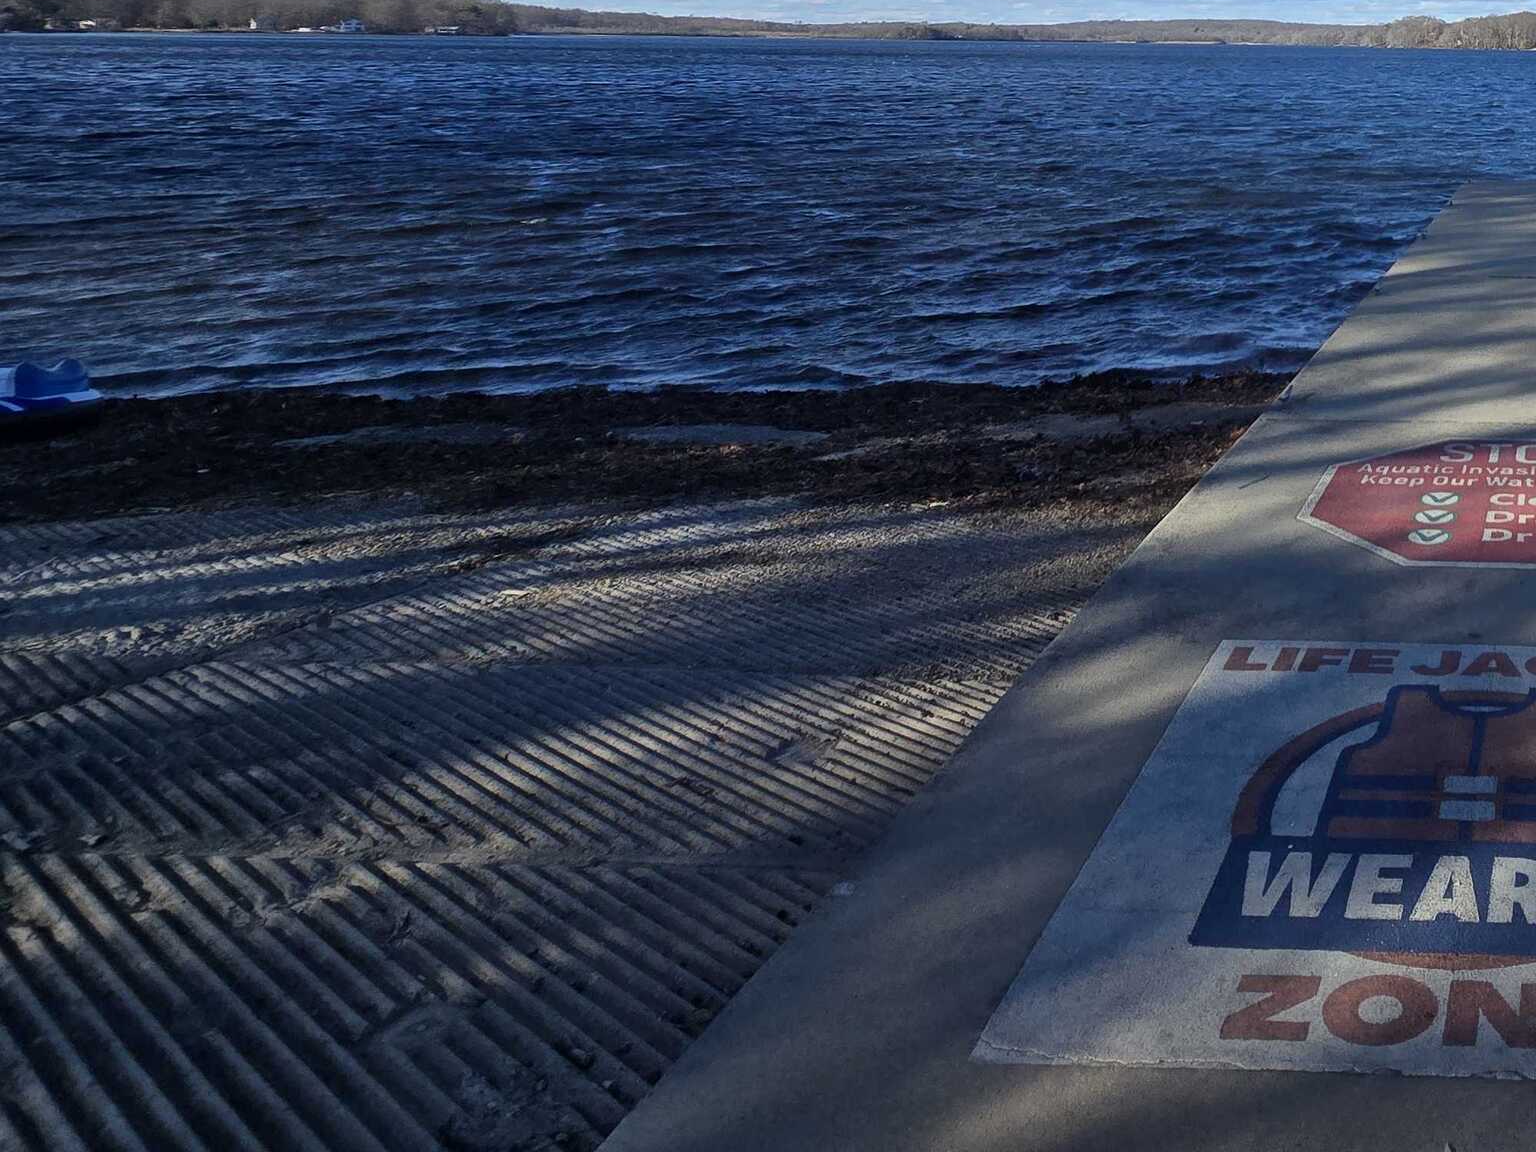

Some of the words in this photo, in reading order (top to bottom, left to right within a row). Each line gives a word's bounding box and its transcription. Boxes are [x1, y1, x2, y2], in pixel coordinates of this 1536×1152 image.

[1357, 463, 1454, 476] Aquatic
[1360, 475, 1425, 487] Keep
[1432, 476, 1479, 487] Our
[1222, 647, 1399, 674] LIFE
